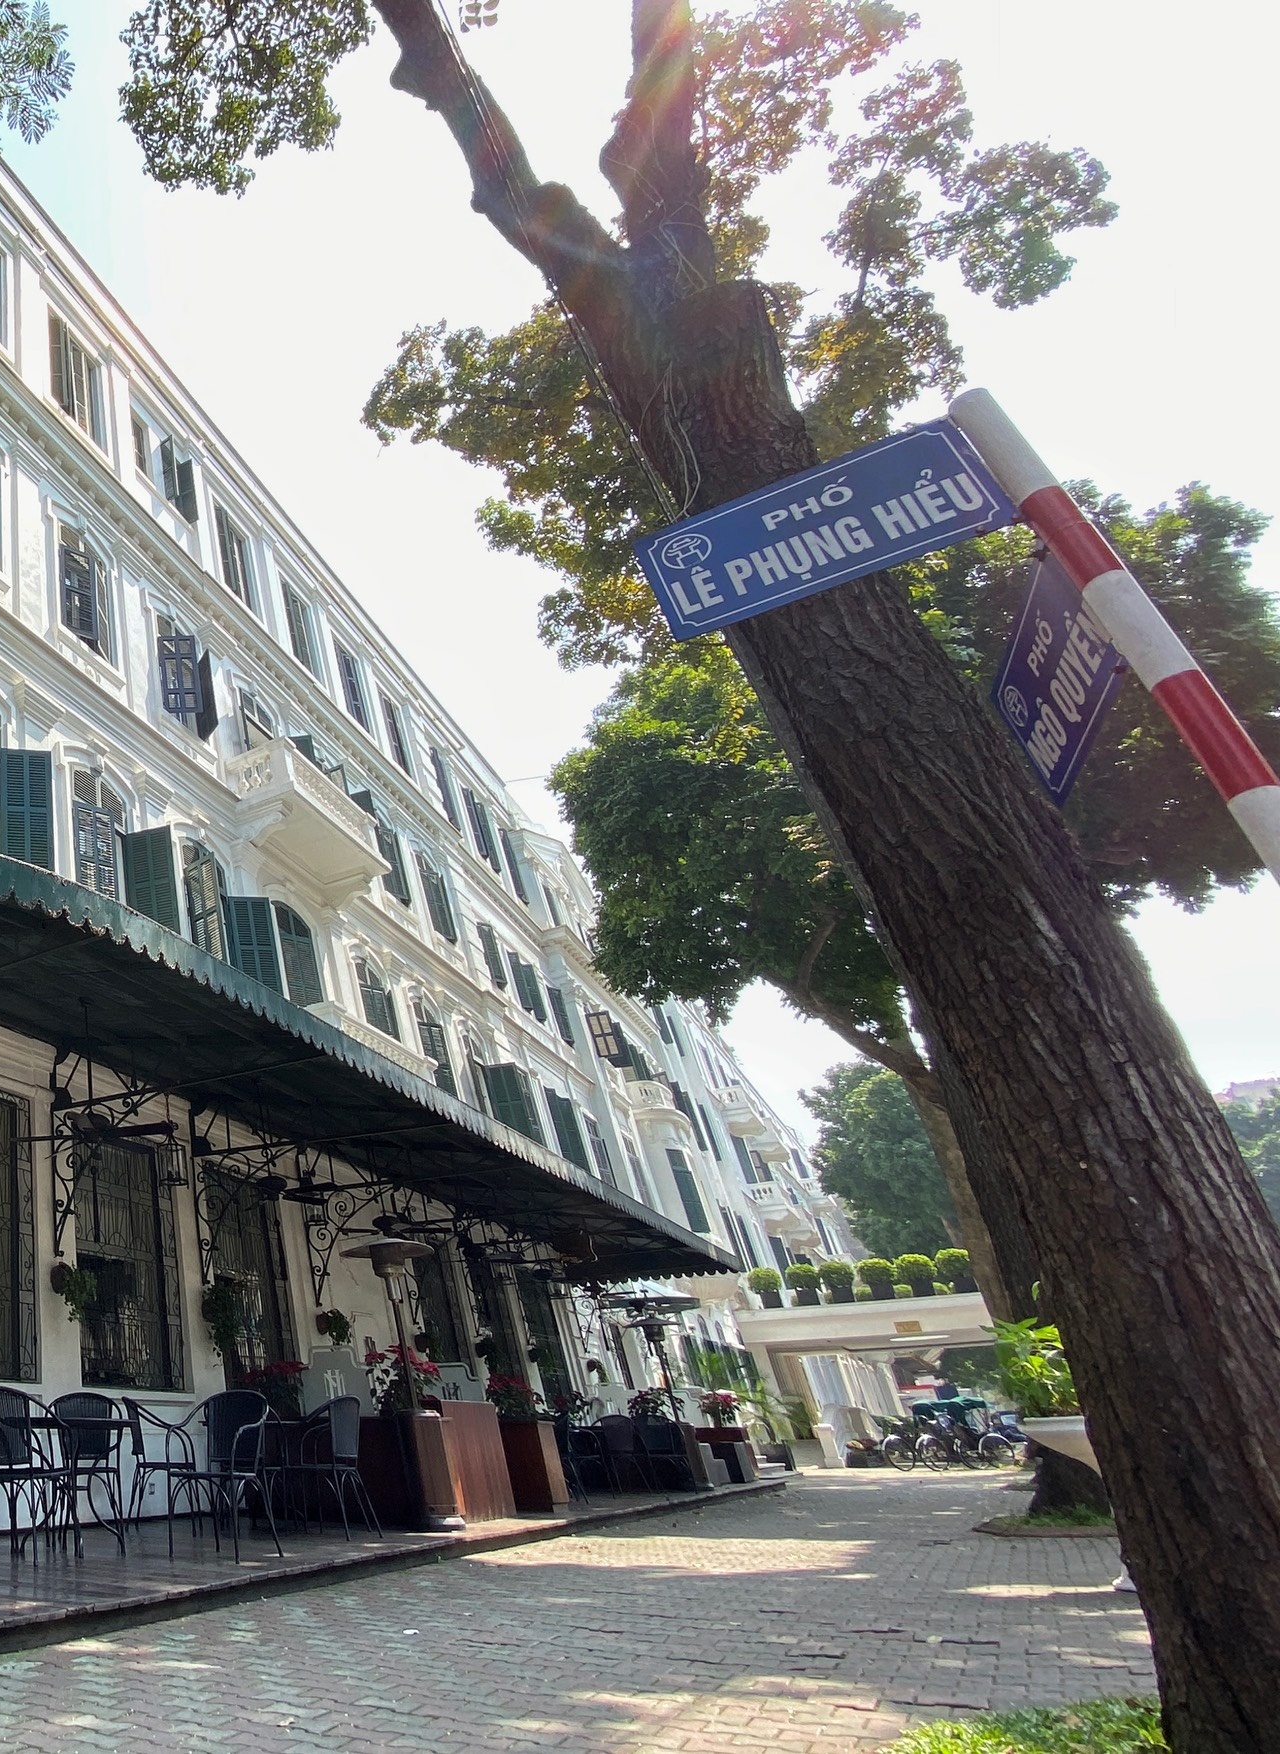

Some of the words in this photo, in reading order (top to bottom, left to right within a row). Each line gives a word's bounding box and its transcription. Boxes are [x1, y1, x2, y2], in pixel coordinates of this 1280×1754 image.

[760, 475, 855, 532] PHỐ
[671, 566, 724, 617] LÊ
[724, 515, 875, 595] PHỤNG
[870, 468, 986, 541] HIỂU
[1026, 608, 1054, 678] PHỐ
[1026, 696, 1068, 780] NGÔ
